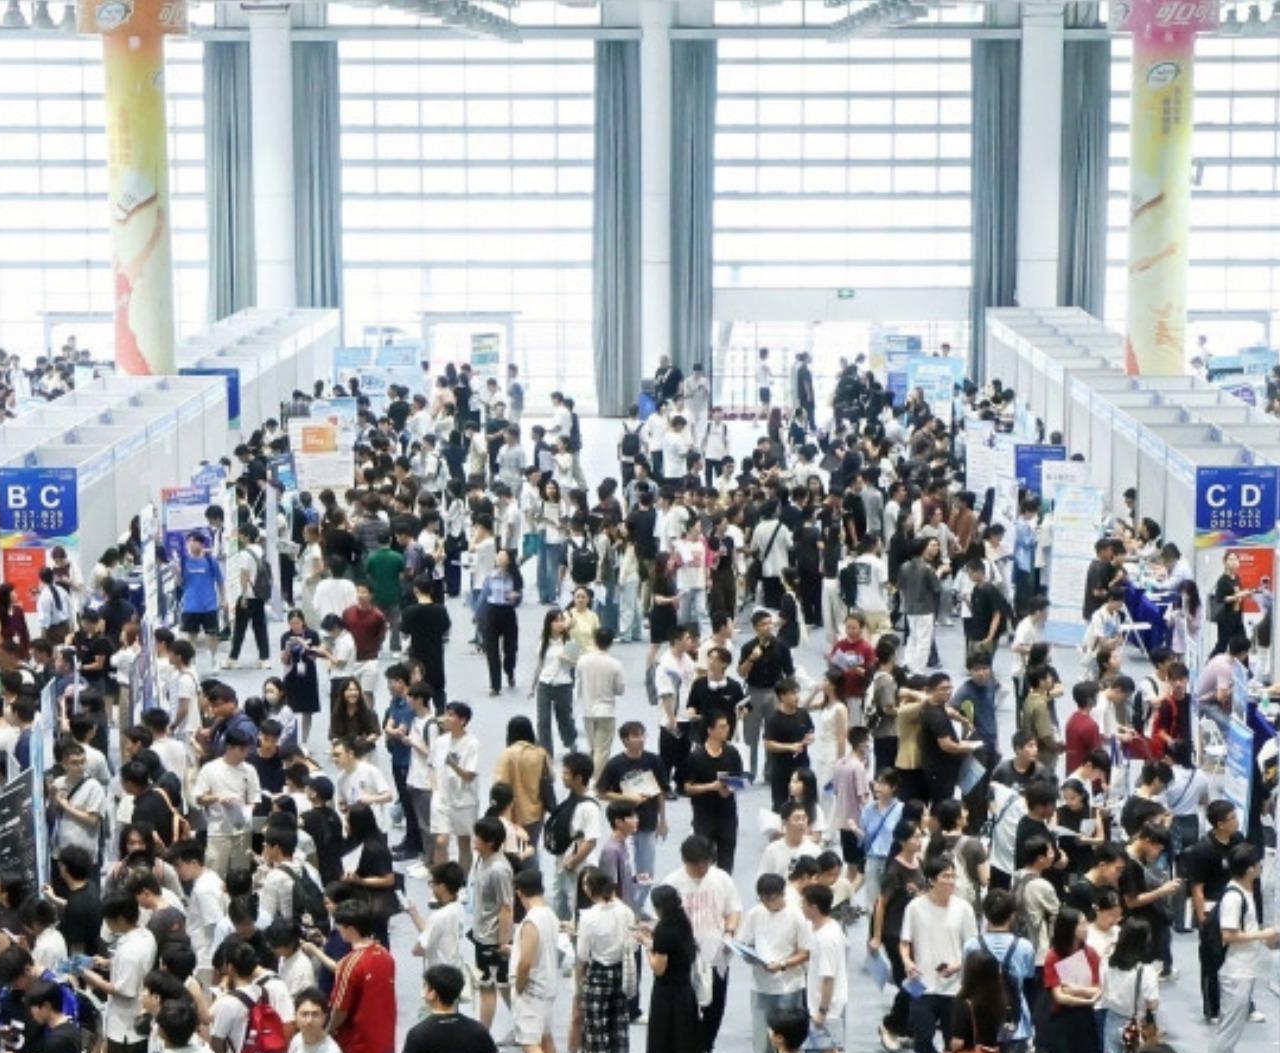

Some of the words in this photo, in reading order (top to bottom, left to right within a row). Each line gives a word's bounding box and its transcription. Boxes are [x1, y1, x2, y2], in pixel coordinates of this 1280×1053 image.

[7, 485, 28, 508] B
[40, 485, 61, 508] C
[1206, 484, 1227, 507] C
[1240, 484, 1261, 507] D
